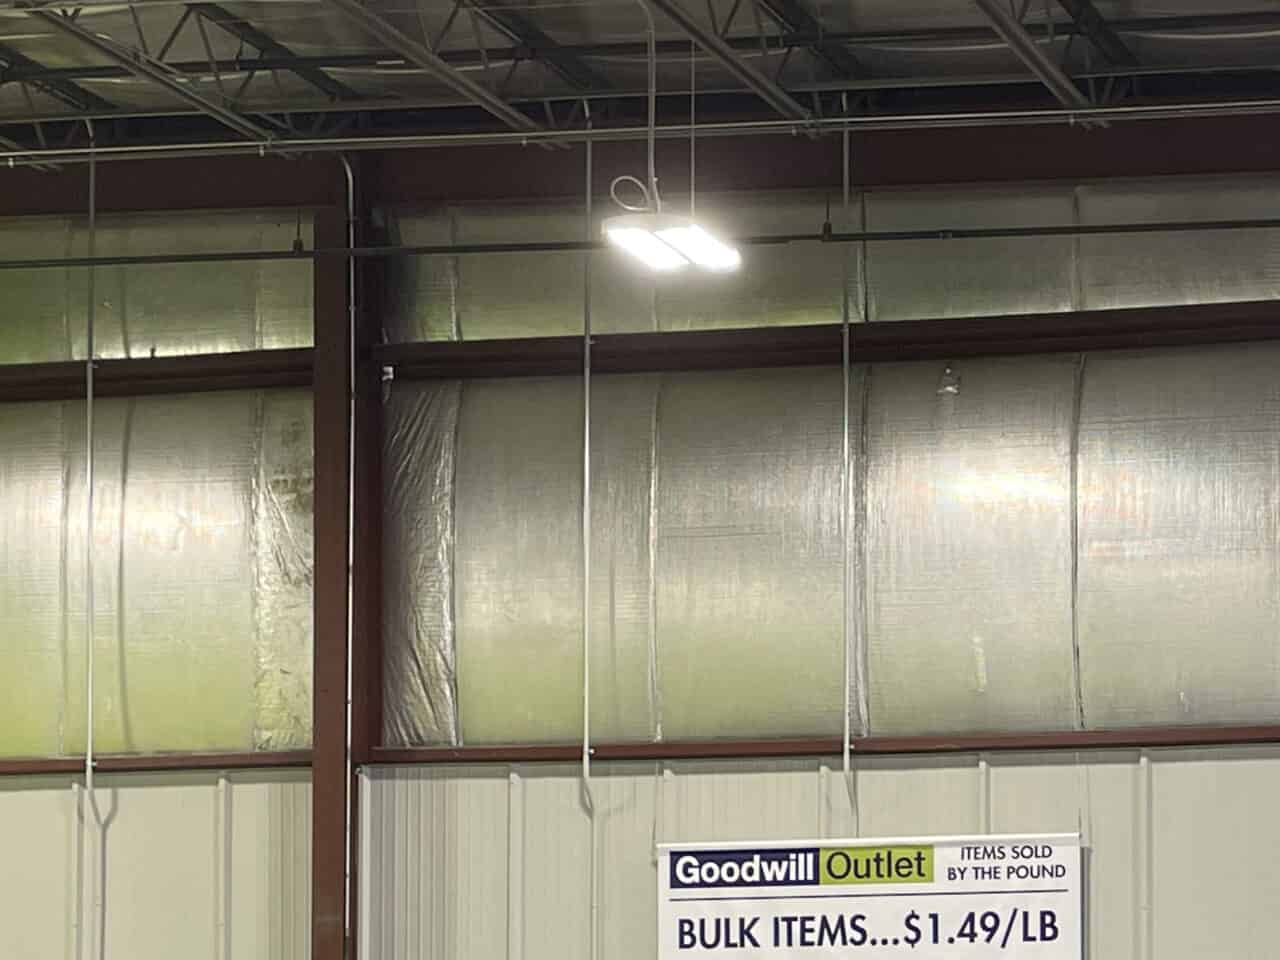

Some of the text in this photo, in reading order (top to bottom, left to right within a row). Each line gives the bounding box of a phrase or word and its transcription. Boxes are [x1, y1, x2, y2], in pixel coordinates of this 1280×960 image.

[961, 845, 1052, 860] ITEMS SOLD
[676, 850, 927, 886] Goodwill Outlet
[948, 865, 1066, 880] BY THE POUND
[679, 917, 760, 949] BULK
